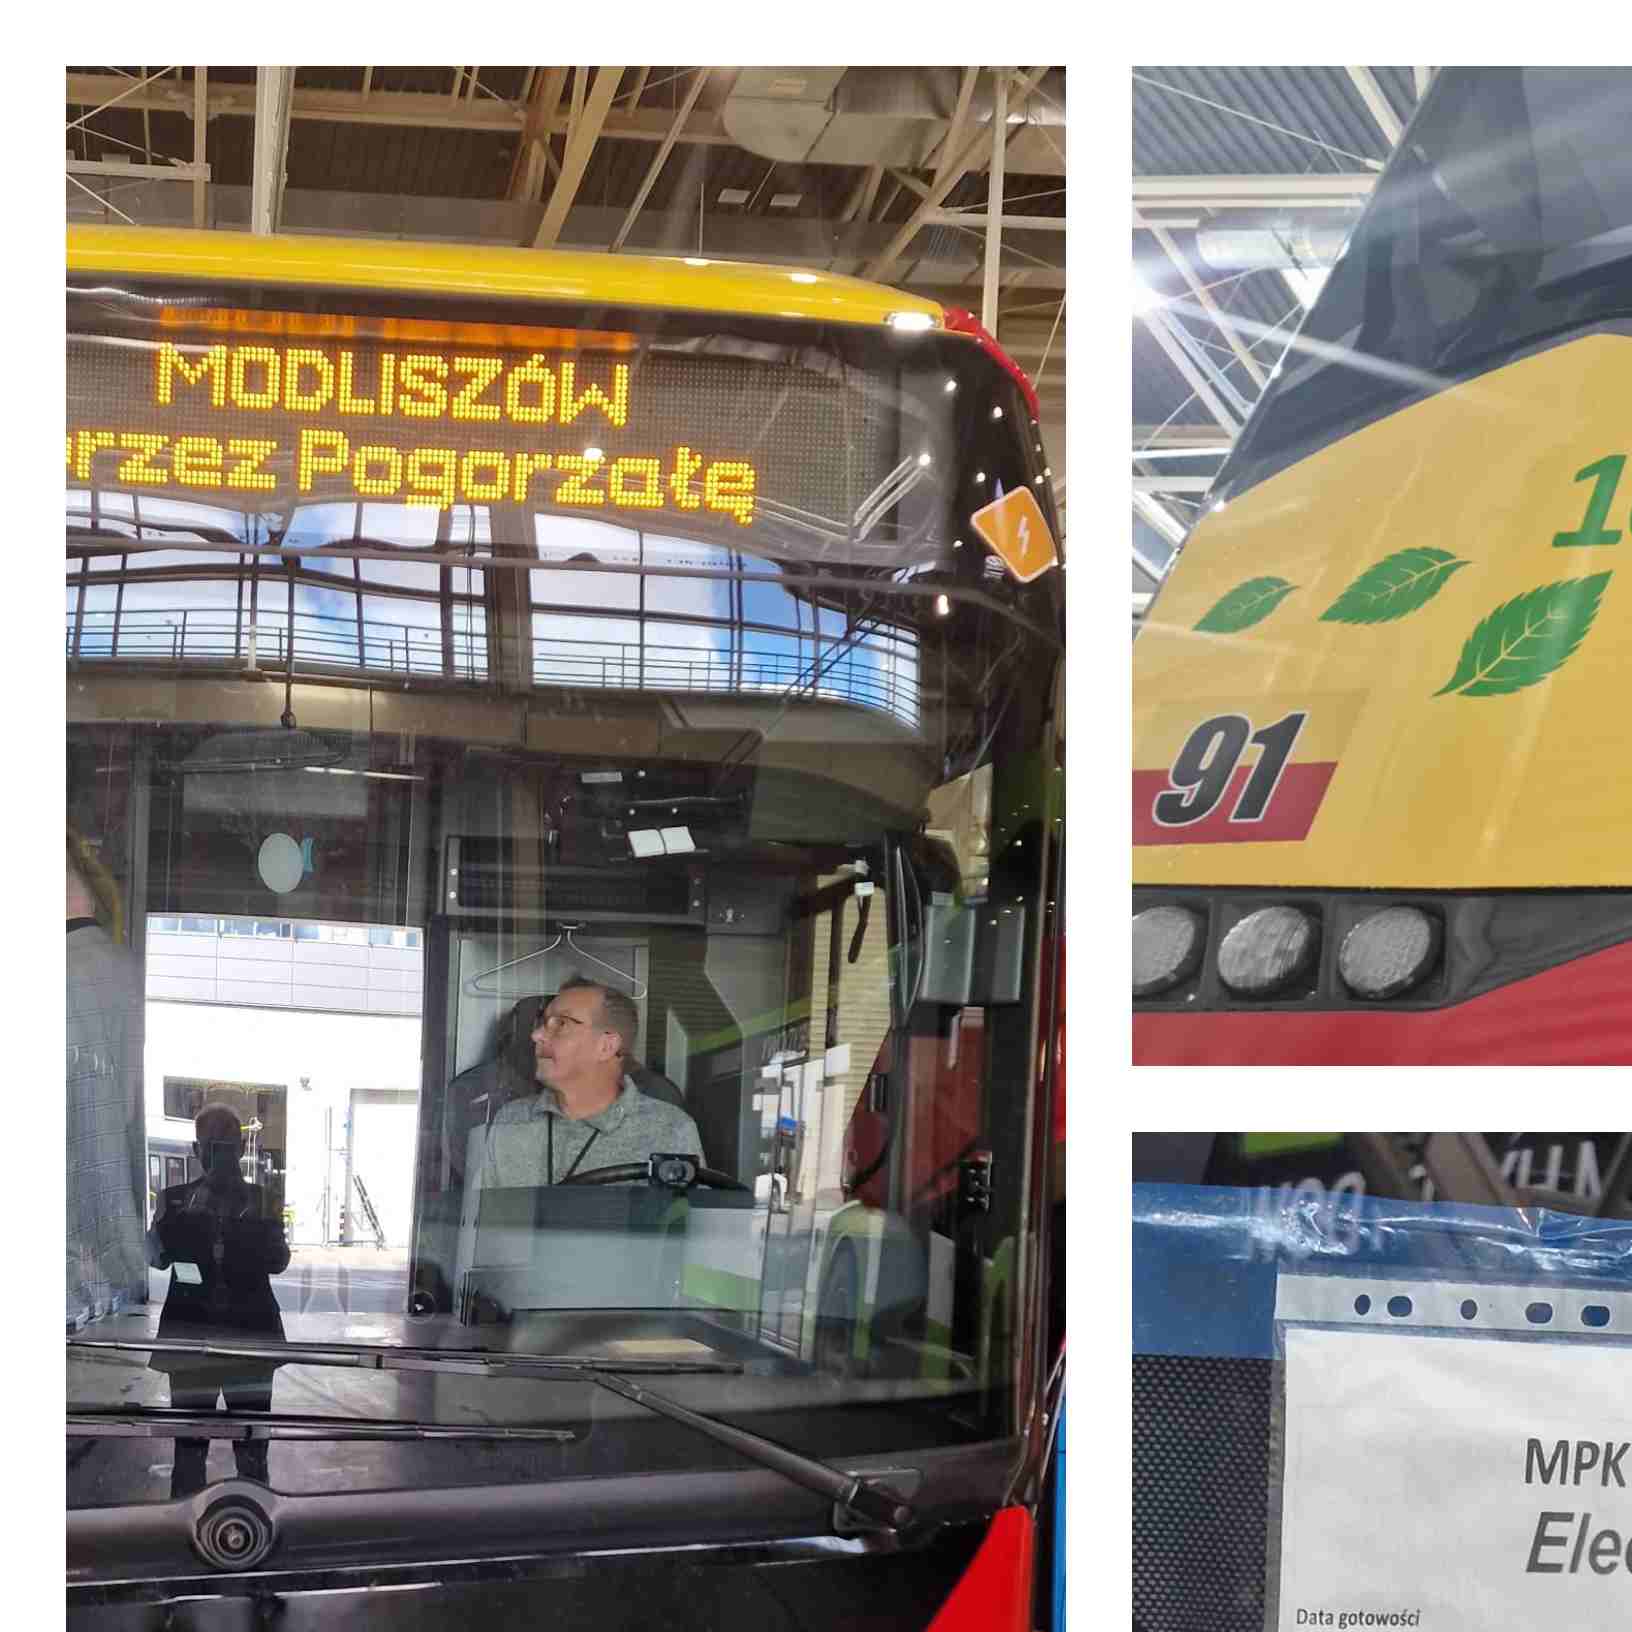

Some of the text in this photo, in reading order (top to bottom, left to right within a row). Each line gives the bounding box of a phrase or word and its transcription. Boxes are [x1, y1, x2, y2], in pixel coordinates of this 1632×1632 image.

[157, 342, 629, 426] MODLISZÓW
[66, 428, 756, 525] rzez Pogorzałę
[1153, 709, 1308, 826] 91
[1524, 1437, 1632, 1488] MPK
[1296, 1607, 1421, 1630] Data gotowości
